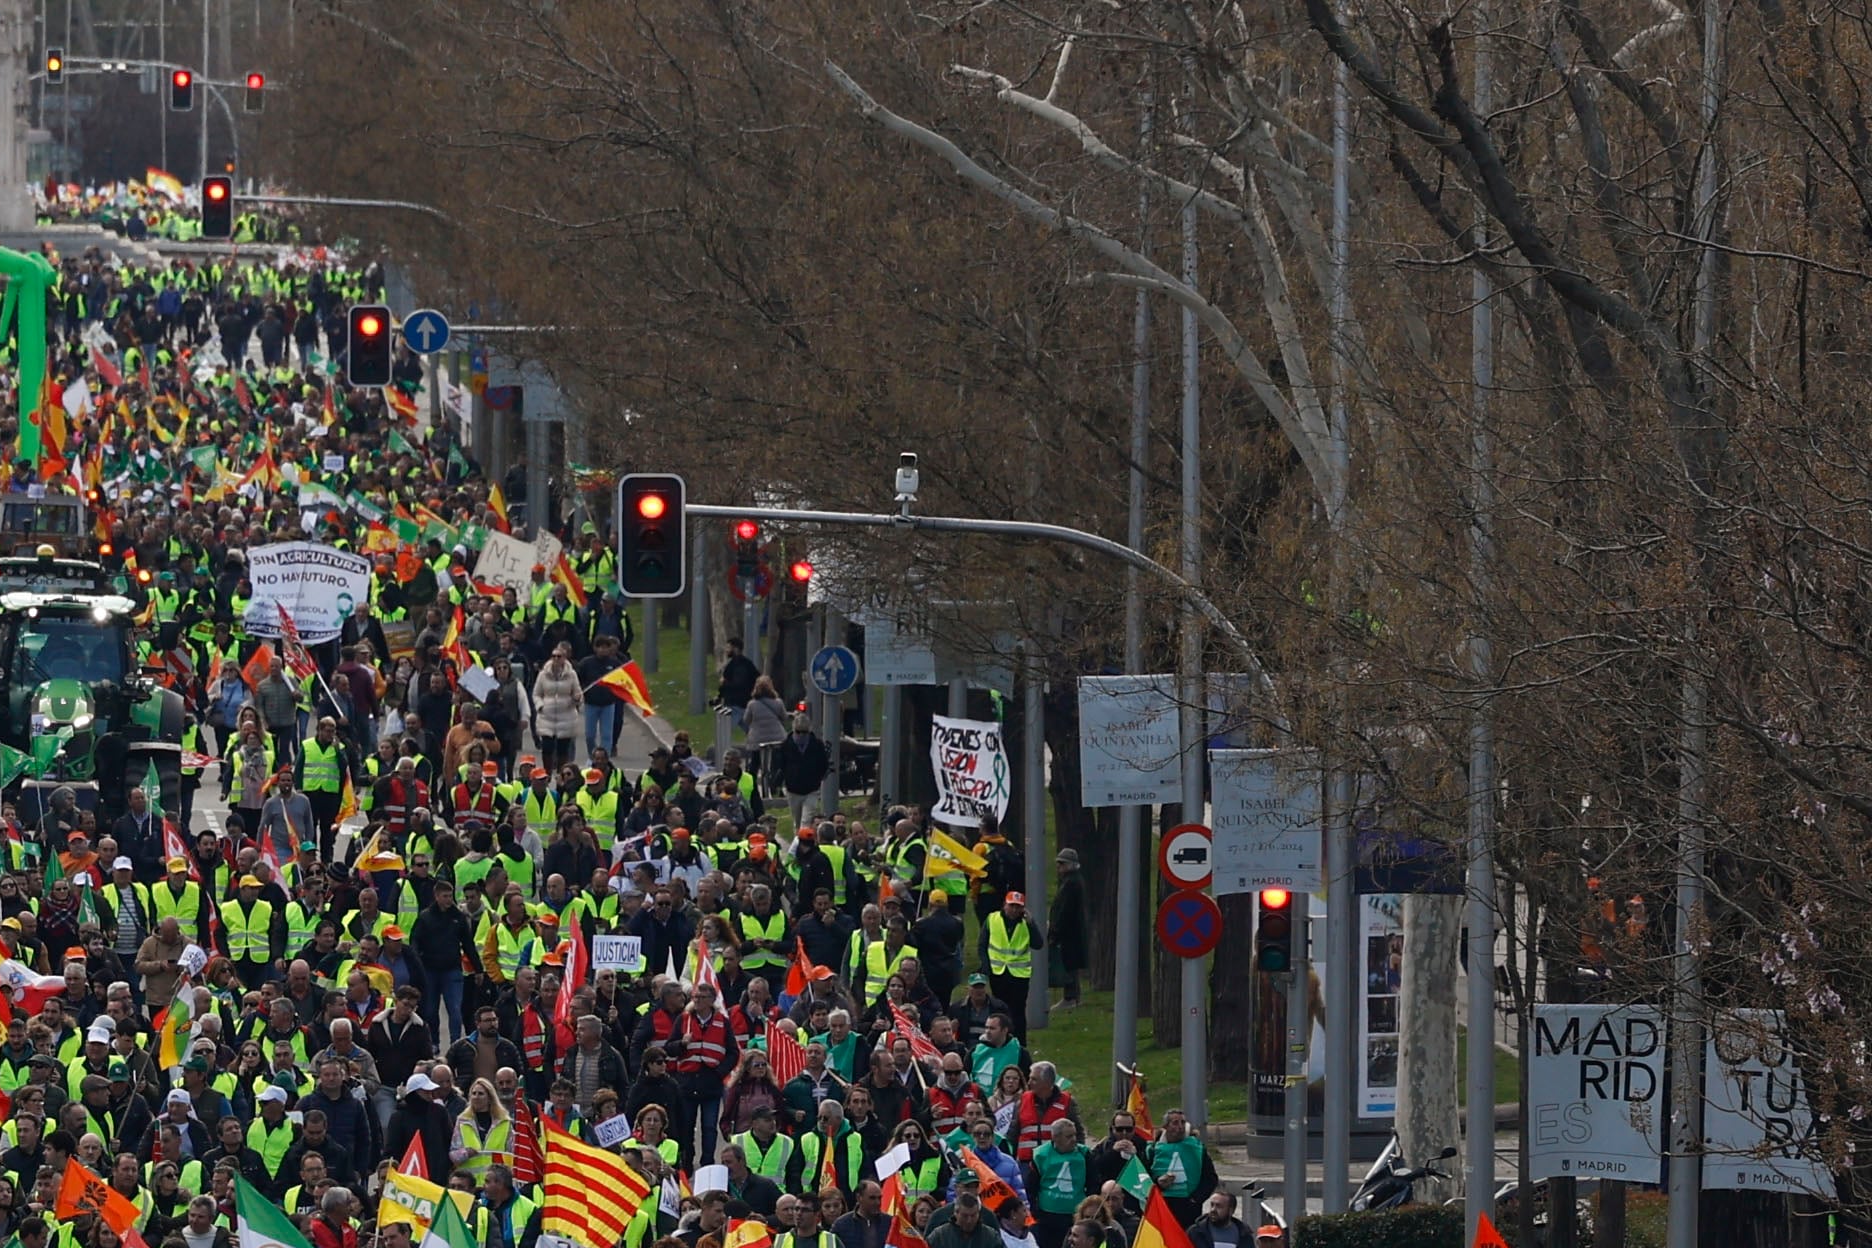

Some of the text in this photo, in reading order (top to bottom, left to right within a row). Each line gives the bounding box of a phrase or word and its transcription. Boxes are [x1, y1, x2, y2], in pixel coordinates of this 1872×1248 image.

[253, 550, 366, 575] SIN AGRICULTURA.
[257, 574, 278, 585] NO
[281, 572, 300, 584] HAY
[1119, 791, 1157, 801] MADRID
[1252, 877, 1293, 886] MADRID
[1535, 1016, 1659, 1057] MAD
[1713, 1017, 1800, 1068] CU
[1260, 1073, 1285, 1085] MARZ
[1578, 1059, 1657, 1102] RID
[1734, 1069, 1798, 1114] TU
[1535, 1102, 1593, 1146] ES
[1577, 1160, 1627, 1173] MADRID
[1752, 1173, 1803, 1186] MADRID
[382, 1182, 432, 1219] COA
